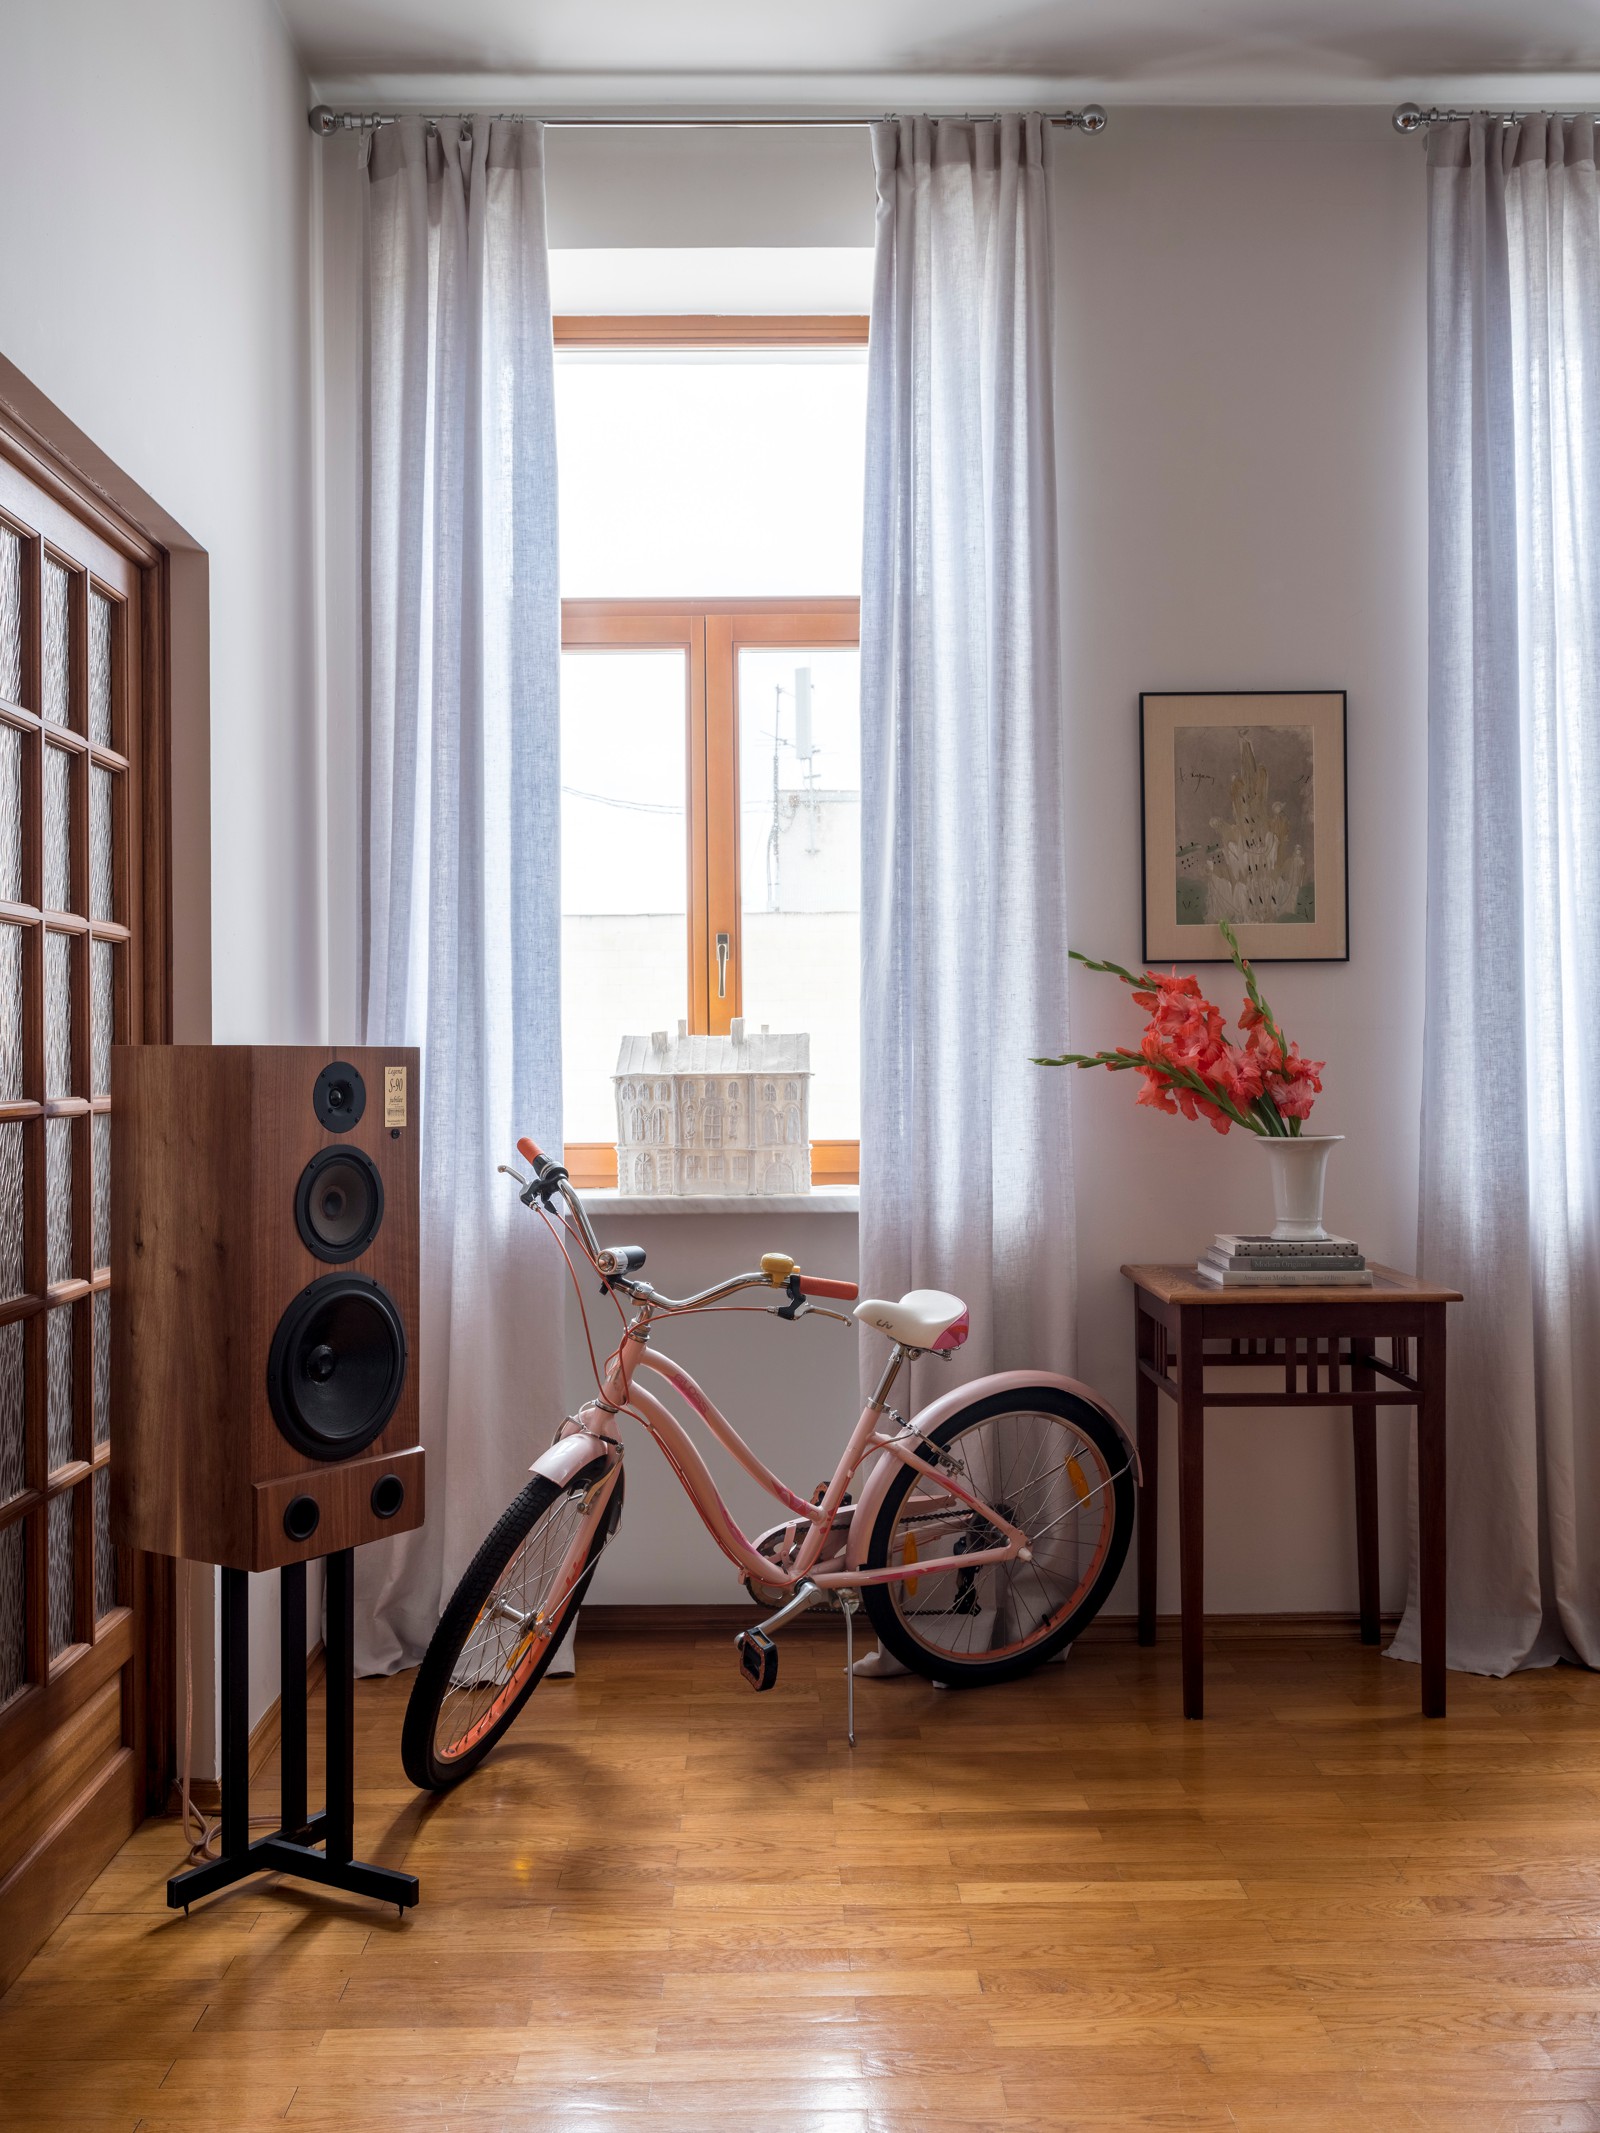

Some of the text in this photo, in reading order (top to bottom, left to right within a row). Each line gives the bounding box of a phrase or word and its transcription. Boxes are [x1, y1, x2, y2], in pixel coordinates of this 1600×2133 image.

[388, 1078, 403, 1093] S-90
[1281, 1260, 1312, 1269] Originals
[876, 1319, 894, 1330] Liv
